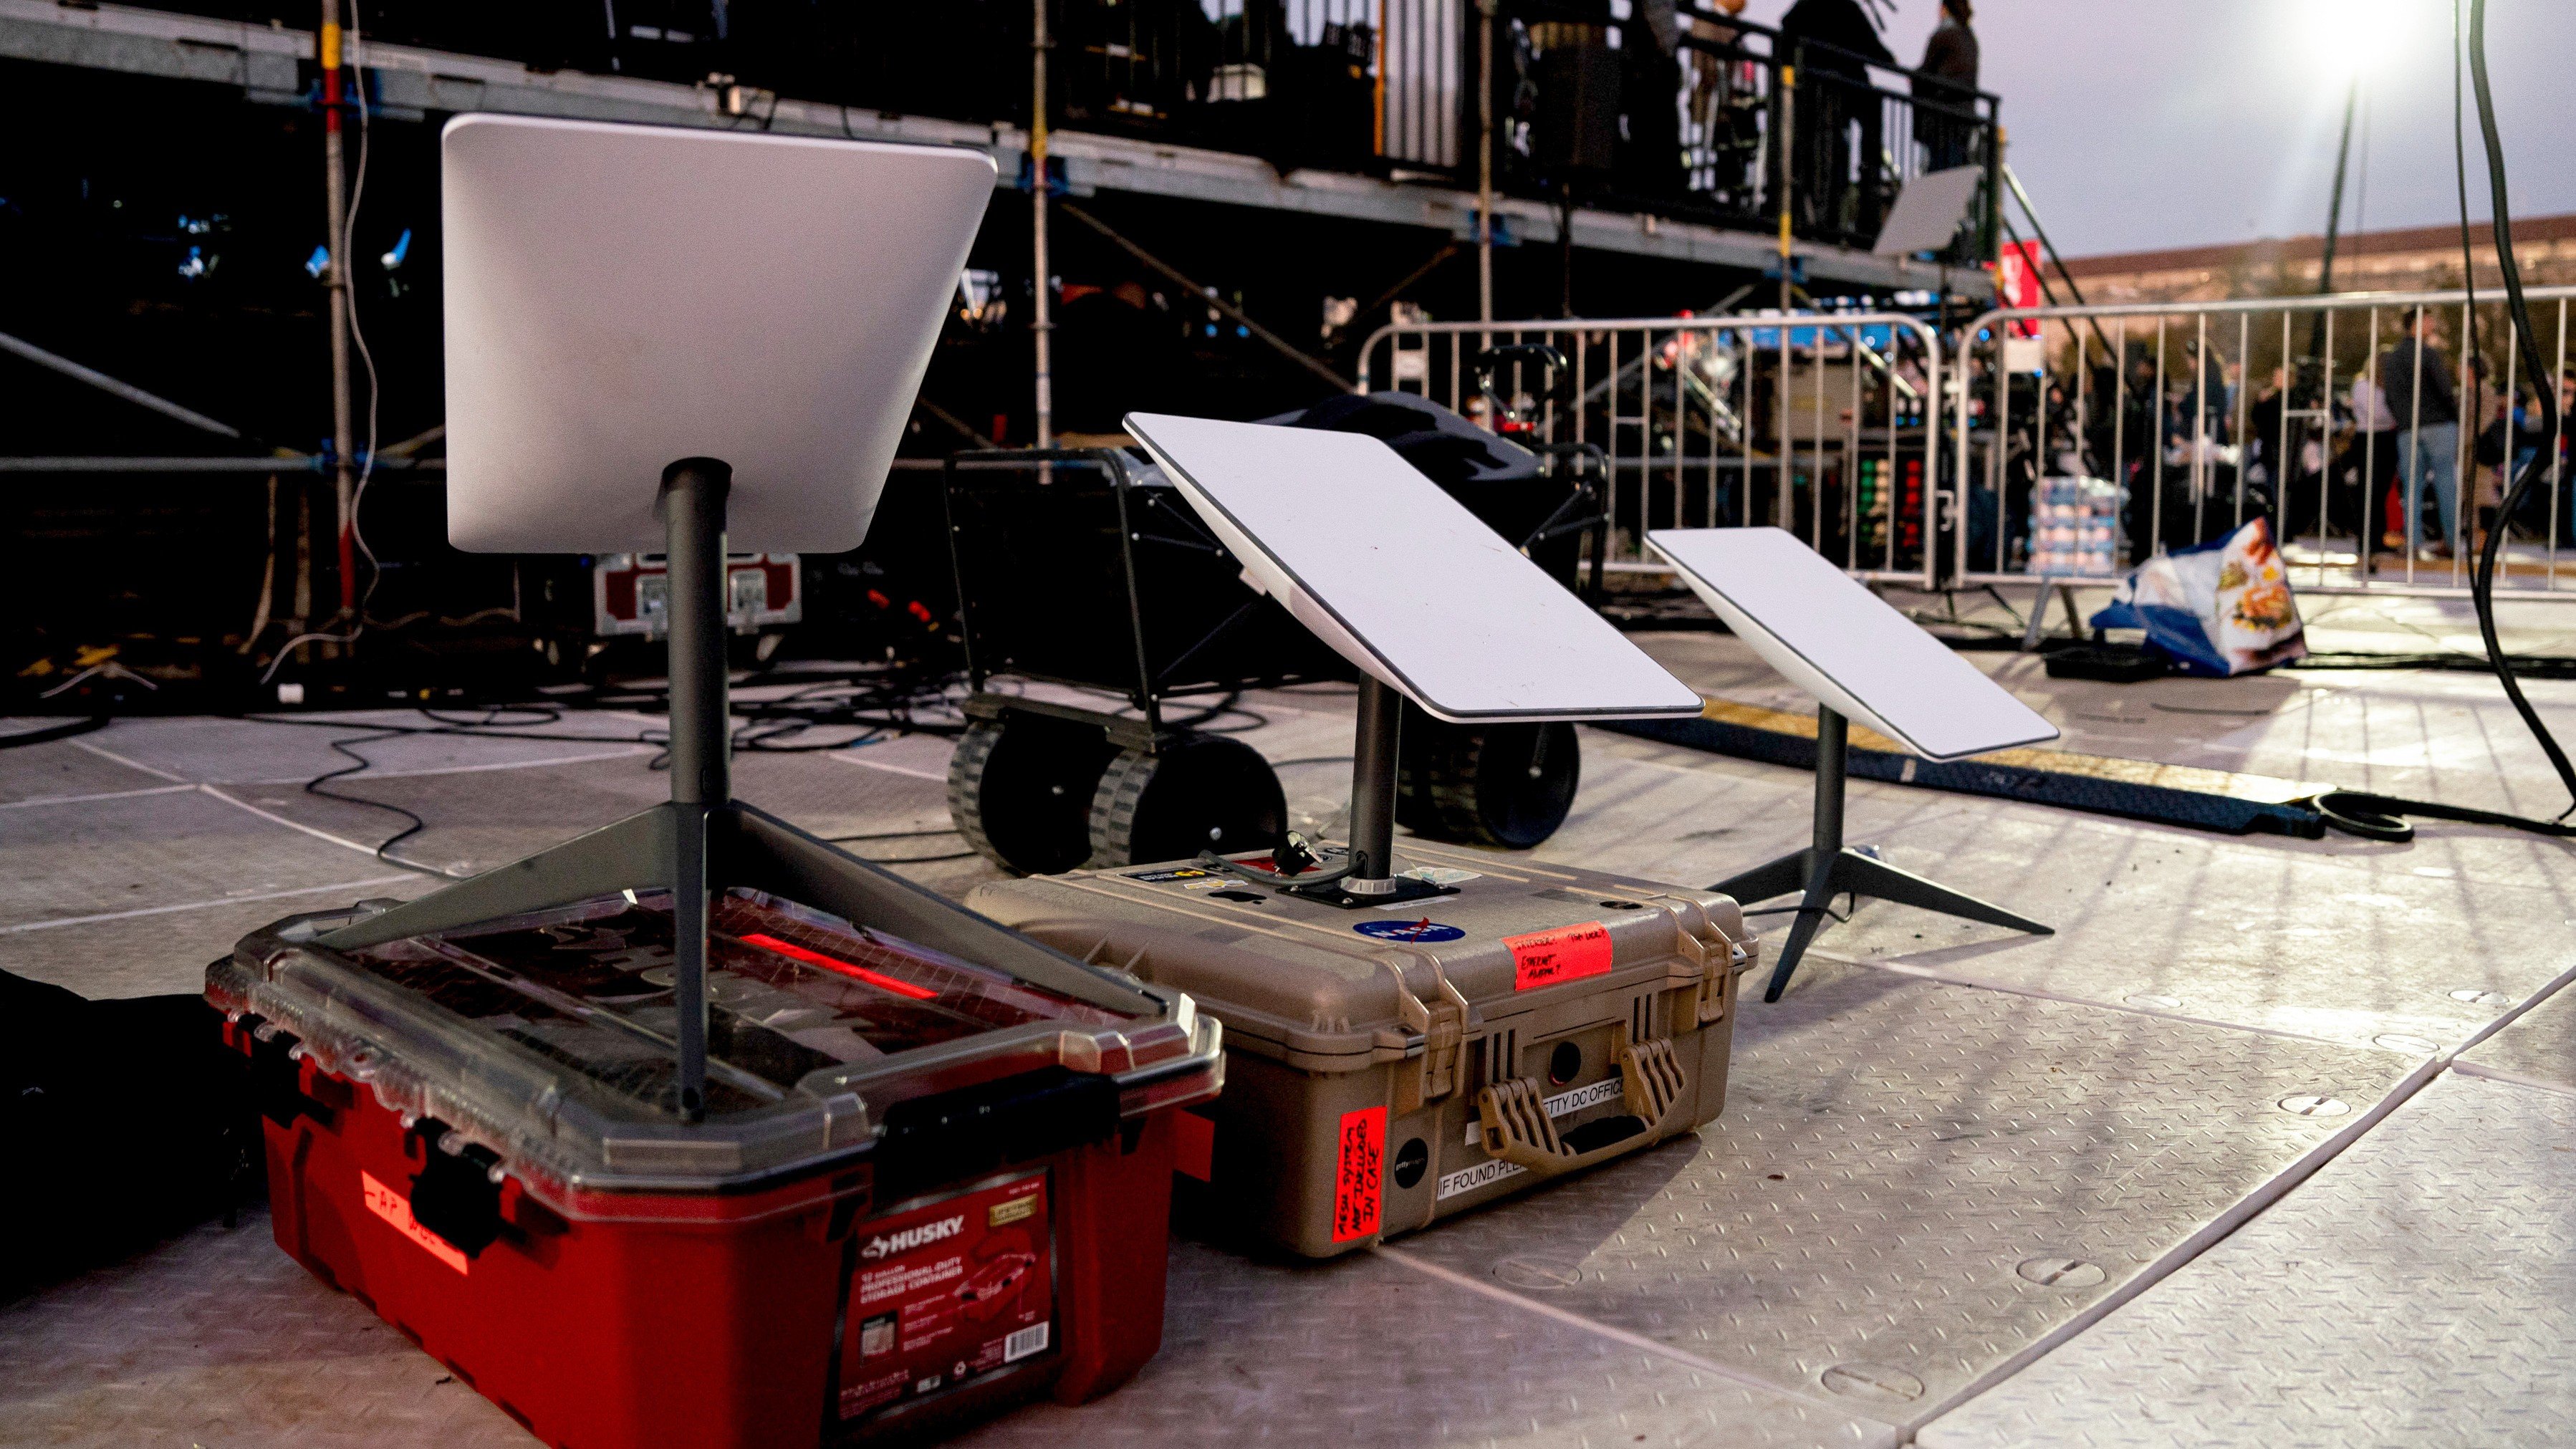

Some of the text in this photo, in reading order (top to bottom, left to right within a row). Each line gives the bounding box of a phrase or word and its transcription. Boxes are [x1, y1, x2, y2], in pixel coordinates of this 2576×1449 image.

[1572, 1090, 1587, 1108] DC
[1352, 1118, 1368, 1232] NOT INCLUDED
[1363, 1142, 1379, 1222] IN CASE
[1439, 1178, 1450, 1195] IF
[1453, 1164, 1495, 1192] FOUND
[890, 1215, 964, 1253] HUSKY
